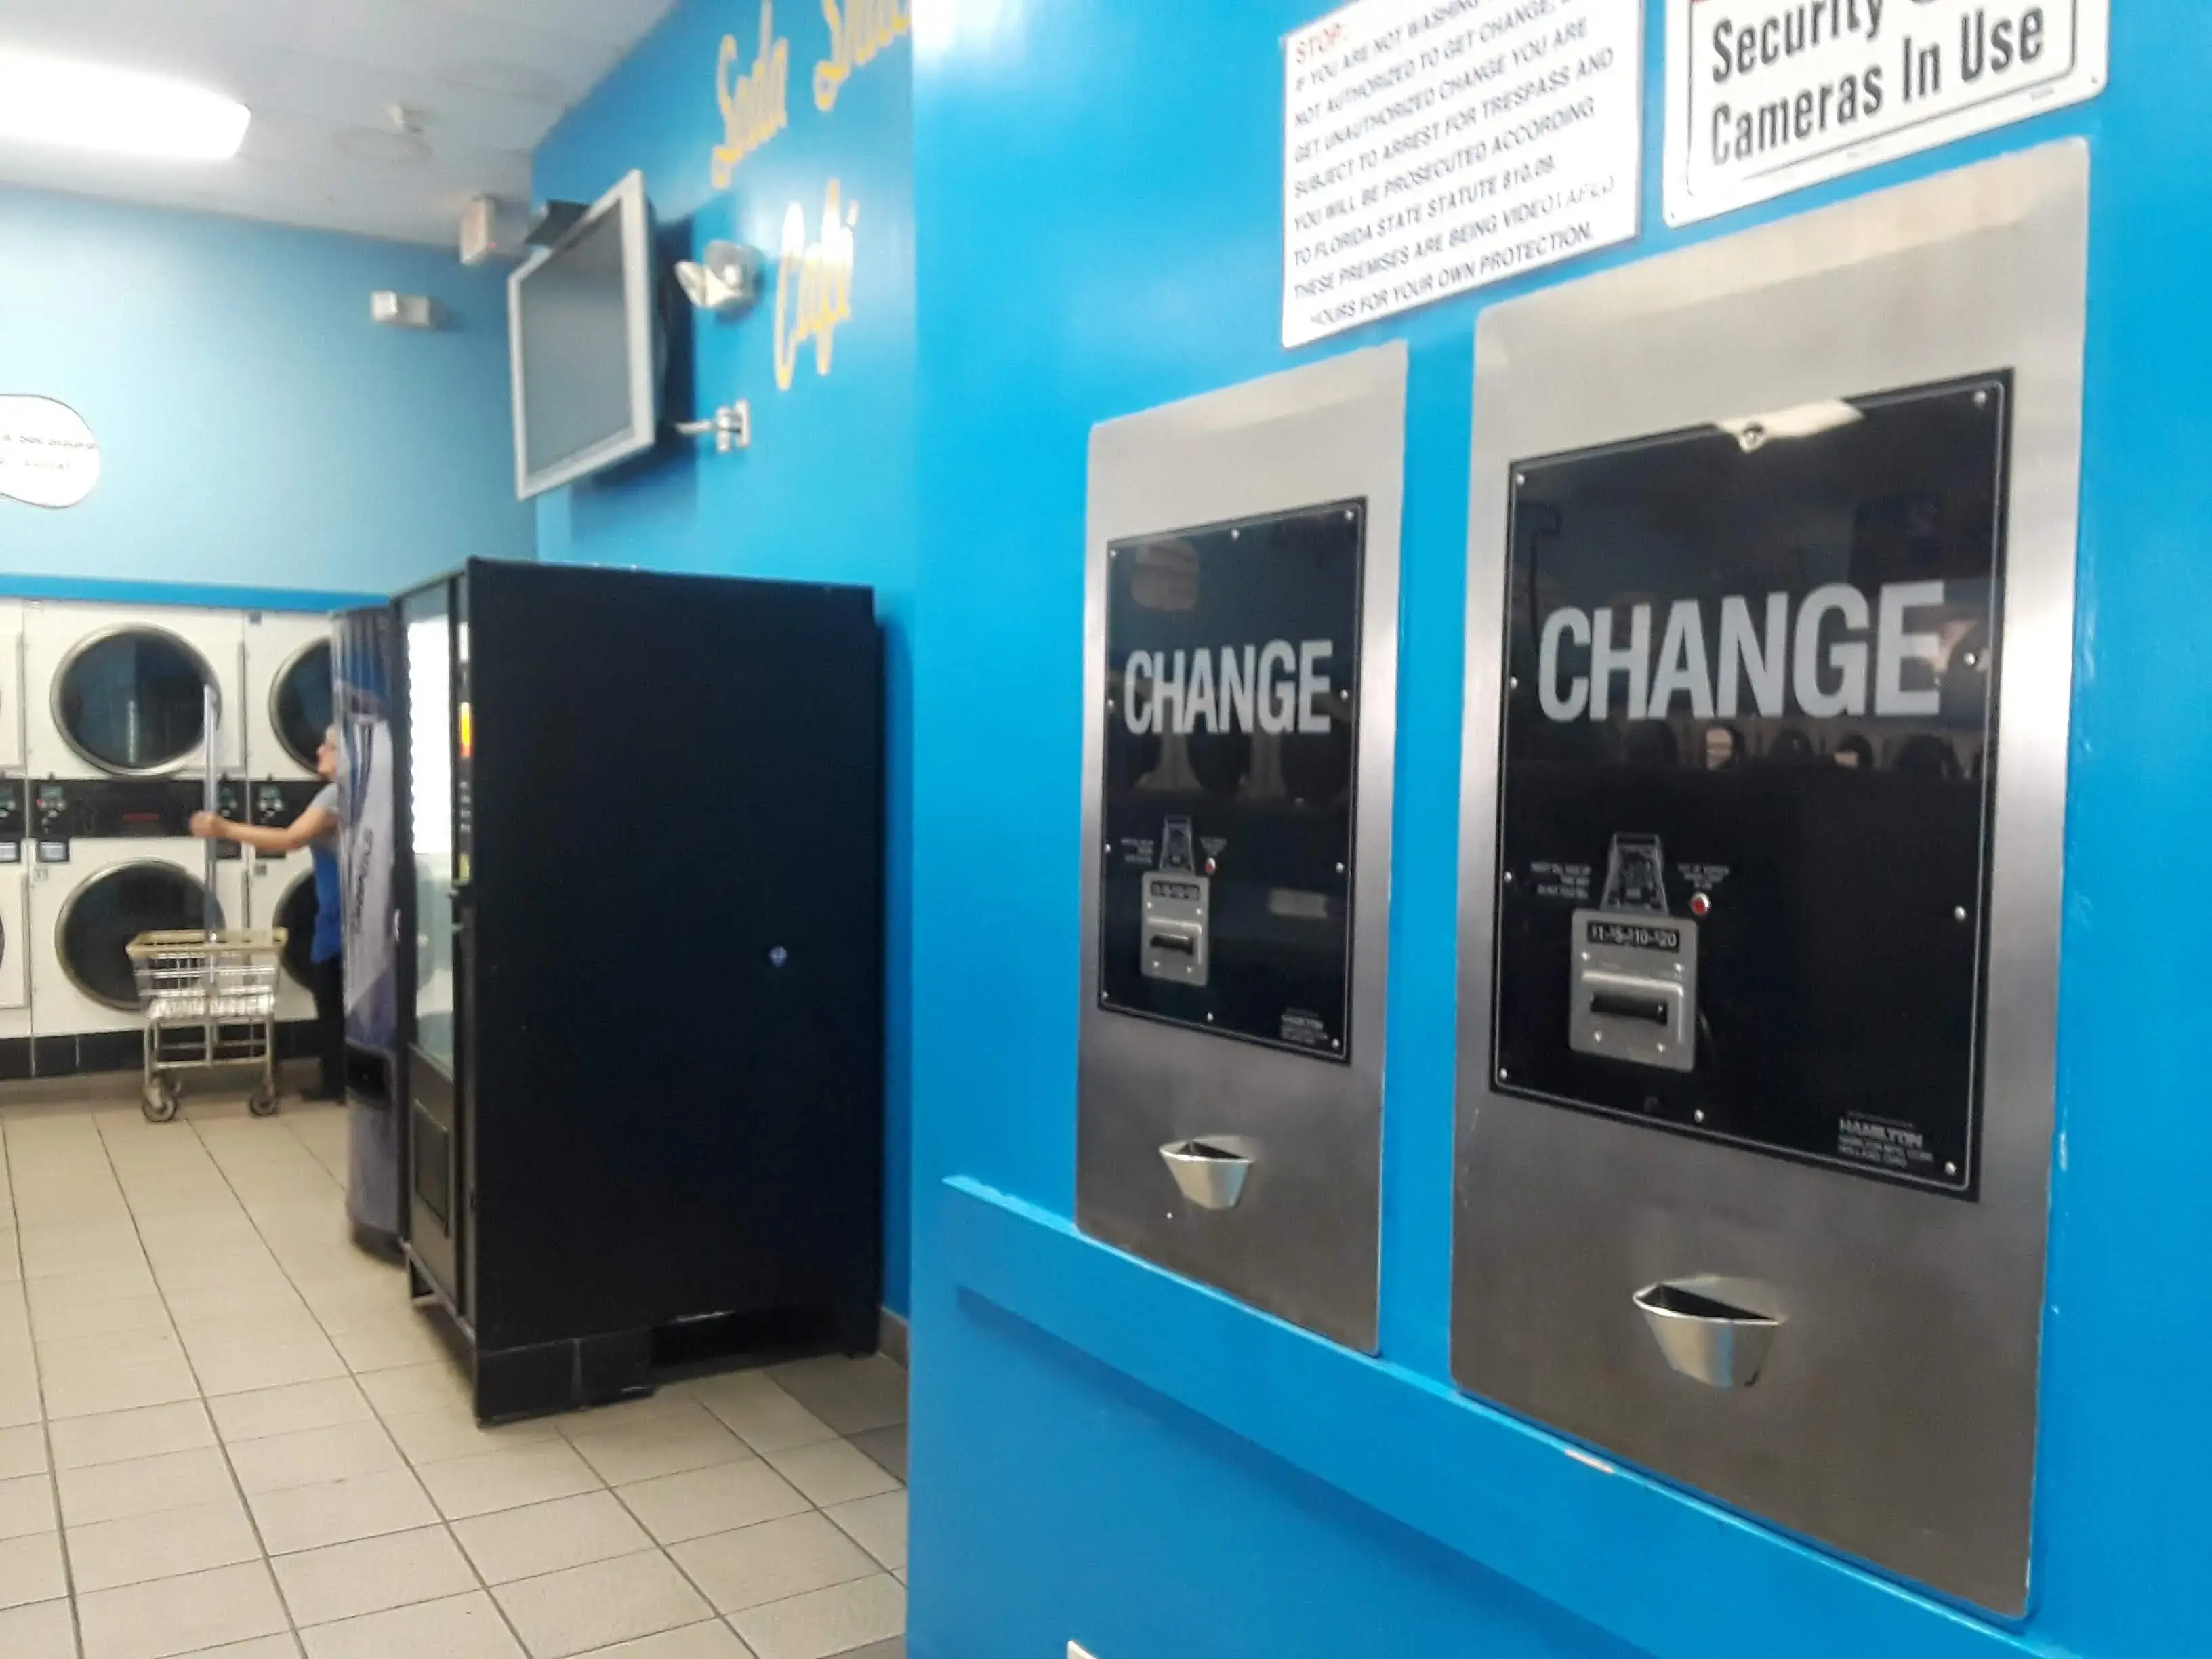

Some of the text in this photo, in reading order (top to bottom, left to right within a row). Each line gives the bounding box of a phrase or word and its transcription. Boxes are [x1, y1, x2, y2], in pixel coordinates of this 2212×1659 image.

[1294, 102, 1322, 127] NOT
[1326, 58, 1414, 112] AUTHORIZED
[1420, 45, 1438, 69] TO
[1443, 29, 1474, 60] GET
[1294, 16, 1587, 164] GET UNAUTHORIZED CHANGE YOU ARE
[1310, 60, 1338, 84] YOU
[1342, 43, 1368, 69] ARE
[1373, 25, 1402, 52] NOT
[1712, 0, 1883, 83] Security
[1712, 6, 2044, 164] Cameras In Use
[1294, 45, 1613, 199] SUBJECT TO ARREST FOR TRESPASS AND
[1294, 95, 1595, 232] YOU WILL BE PROSECUTED ACCORDING
[1294, 247, 1311, 266] TO
[1314, 224, 1372, 259] FLORIDA
[1376, 202, 1421, 237] STATE
[1427, 175, 1497, 218] STATUTE
[1294, 271, 1334, 299] THESE
[1339, 245, 1410, 285] PREMISES
[1413, 232, 1443, 260] ARE
[1448, 213, 1498, 247] BEING
[1361, 287, 1388, 314] FOR
[1394, 272, 1432, 303] YOUR
[1437, 260, 1475, 287] OWN
[1124, 639, 1333, 735] CHANGE
[1538, 581, 1945, 722] CHANGE
